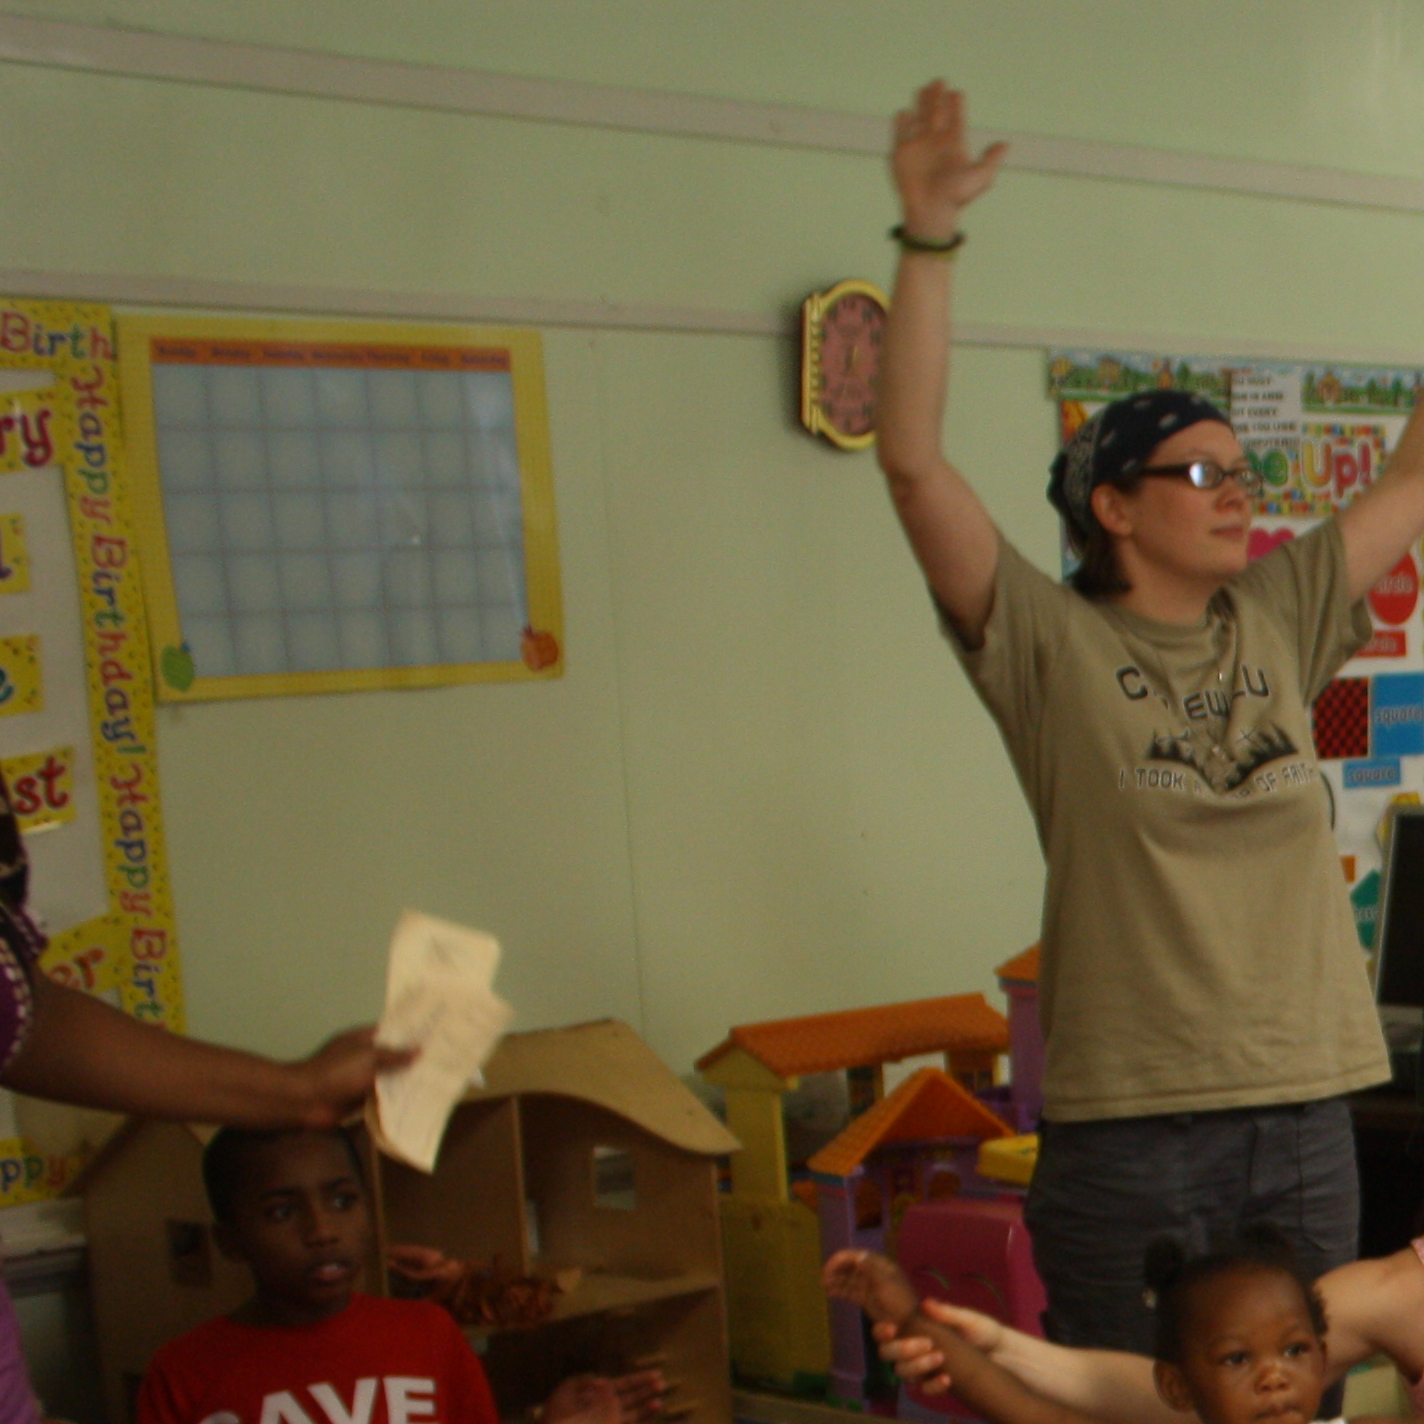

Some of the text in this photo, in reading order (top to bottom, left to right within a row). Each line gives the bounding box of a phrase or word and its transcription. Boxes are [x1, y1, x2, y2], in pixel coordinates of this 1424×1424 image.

[70, 364, 113, 526] Happy
[1302, 441, 1371, 500] Up!
[1136, 768, 1185, 789] TOOK
[107, 763, 153, 918] Happy
[129, 926, 167, 1031] Birt
